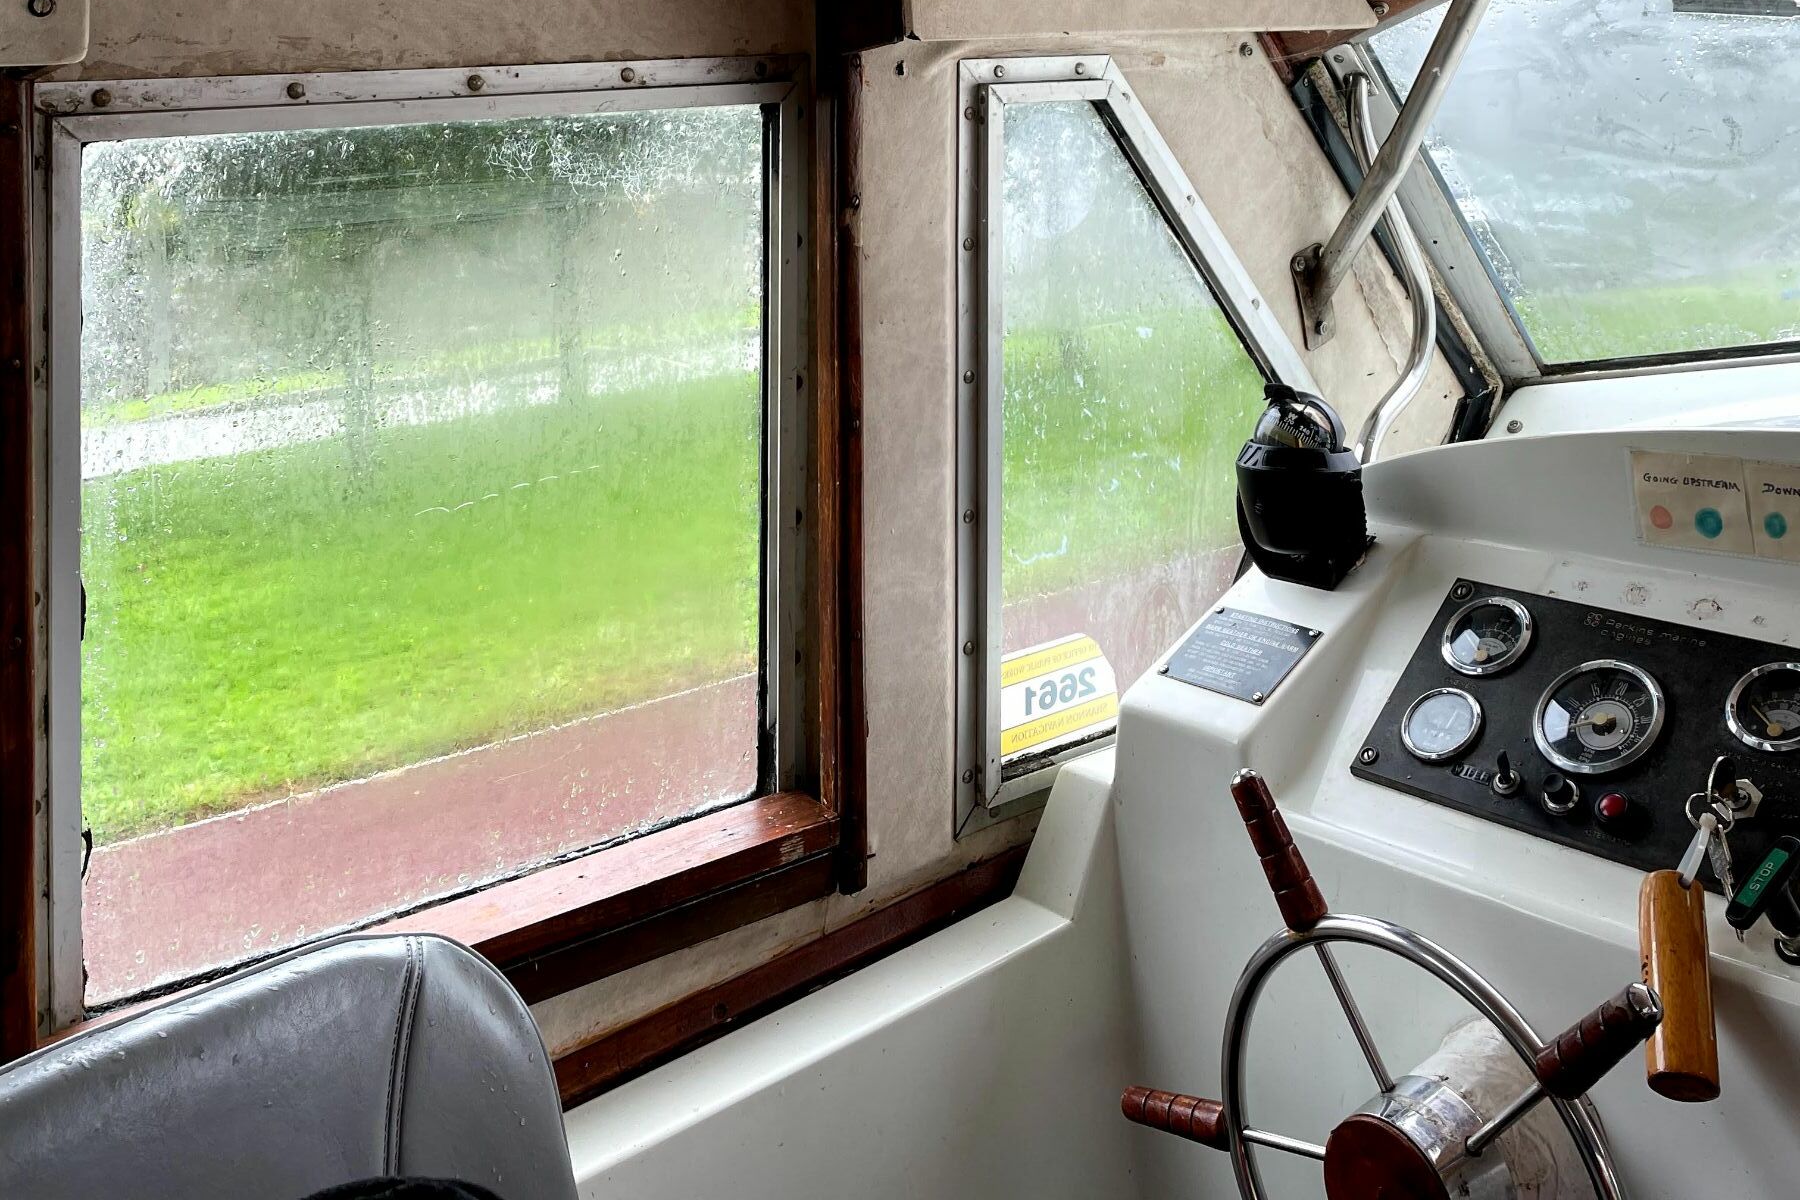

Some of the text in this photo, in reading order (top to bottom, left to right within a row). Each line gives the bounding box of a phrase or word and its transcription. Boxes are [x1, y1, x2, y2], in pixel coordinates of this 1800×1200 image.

[1643, 472, 1741, 493] GOING UPSTREAM
[1258, 618, 1300, 635] INSTRUCTIONS
[1605, 618, 1707, 647] Perkins marine
[1615, 681, 1629, 696] 20
[1749, 861, 1774, 891] STOP
